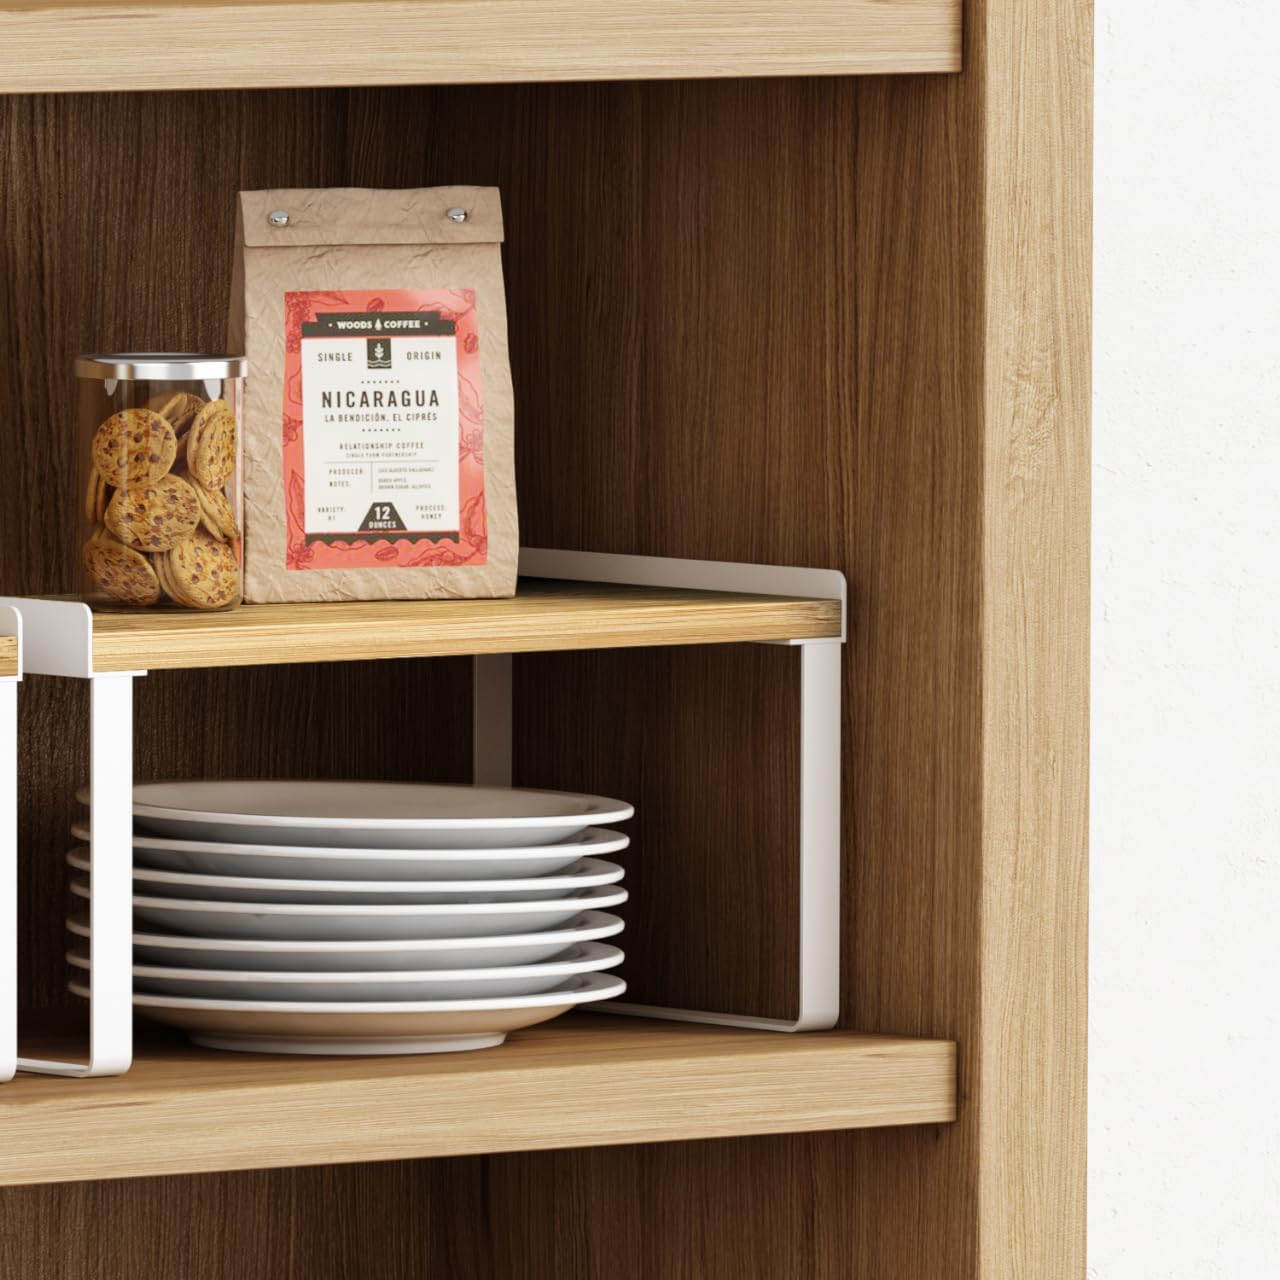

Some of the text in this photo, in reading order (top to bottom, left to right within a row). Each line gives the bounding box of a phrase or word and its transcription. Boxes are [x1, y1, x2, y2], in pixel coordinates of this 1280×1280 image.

[336, 319, 421, 330] WOODS COFFEE
[317, 352, 353, 362] SINGLE
[406, 351, 442, 361] ORIGIN
[322, 390, 439, 408] NICARAGUA
[324, 413, 335, 422] LA
[392, 413, 403, 422] EL
[339, 441, 425, 450] RELATIONSHIP COFFEE
[374, 506, 391, 520] 12
[368, 521, 397, 529] OUNCES
